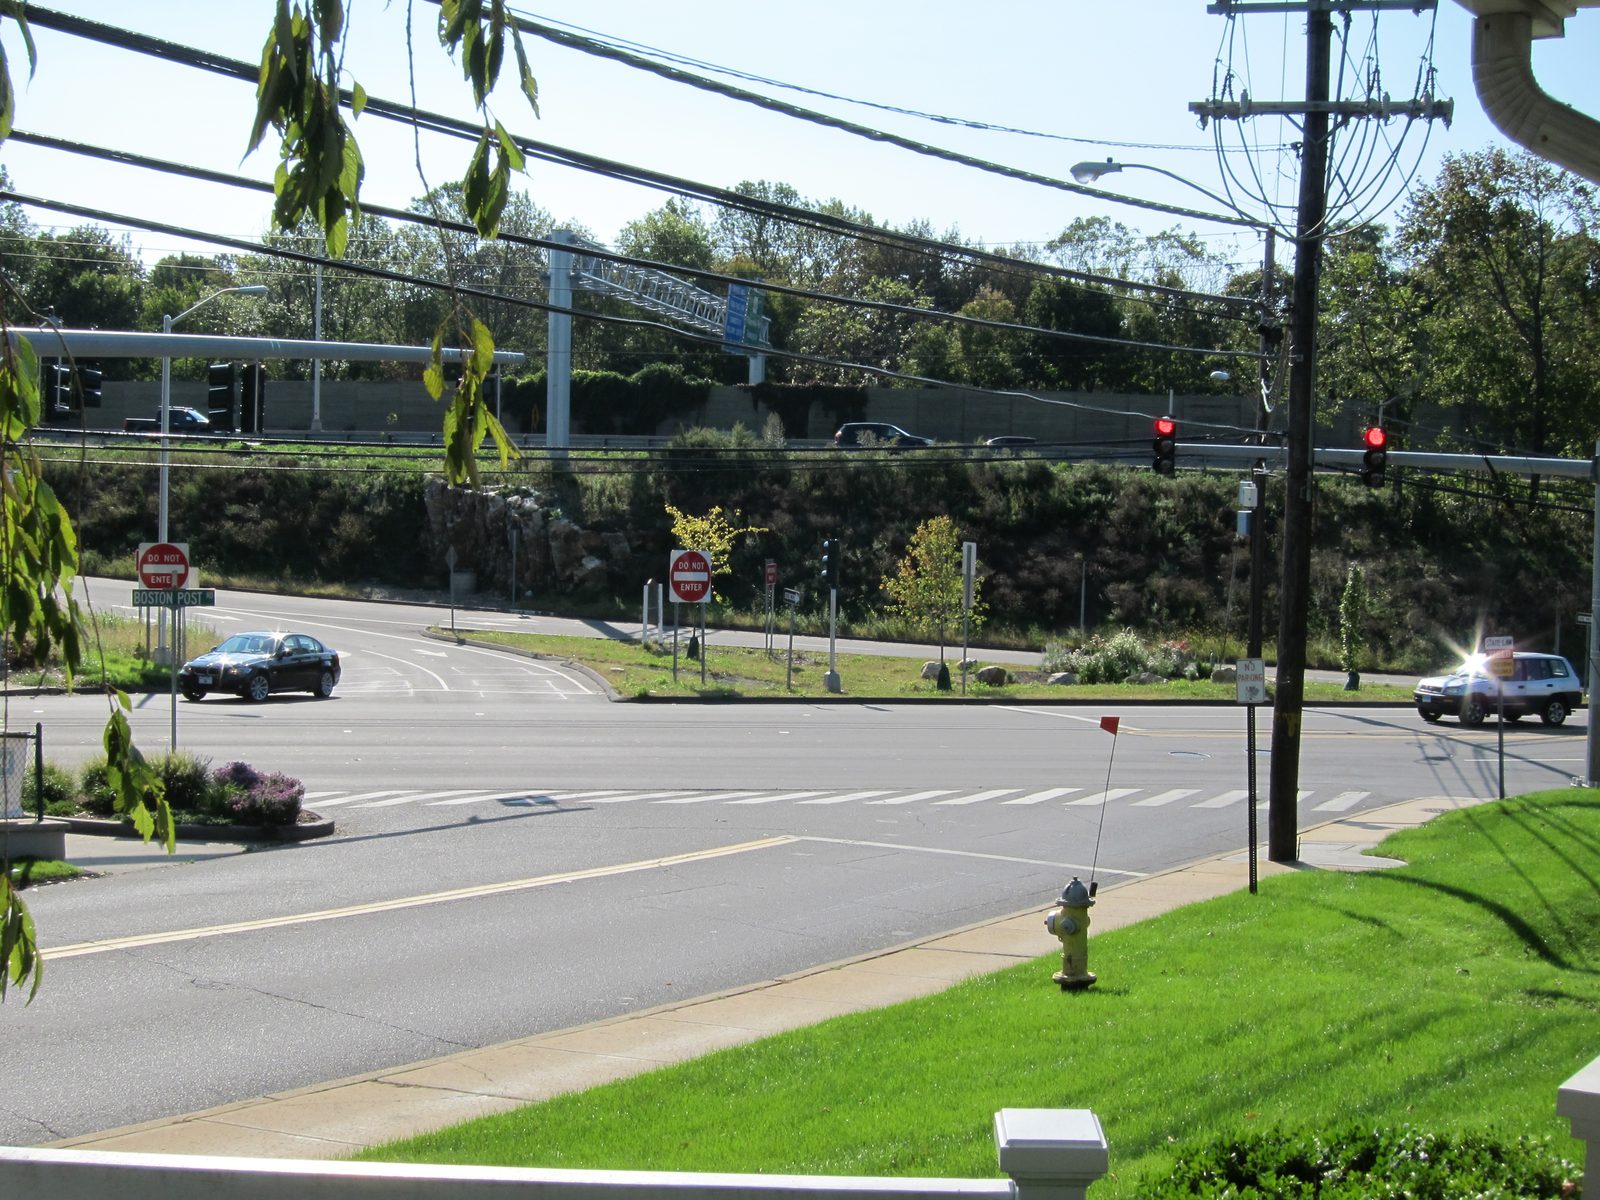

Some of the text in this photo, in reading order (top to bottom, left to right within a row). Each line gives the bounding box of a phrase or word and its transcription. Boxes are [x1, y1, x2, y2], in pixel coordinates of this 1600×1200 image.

[147, 554, 180, 562] DO NOT
[678, 561, 705, 570] DO NOT
[150, 575, 177, 584] ENTE
[680, 583, 703, 591] ENTER
[133, 591, 173, 605] BOSTON
[177, 591, 202, 605] POST
[1244, 662, 1256, 671] NO
[1236, 673, 1264, 682] PARKING
